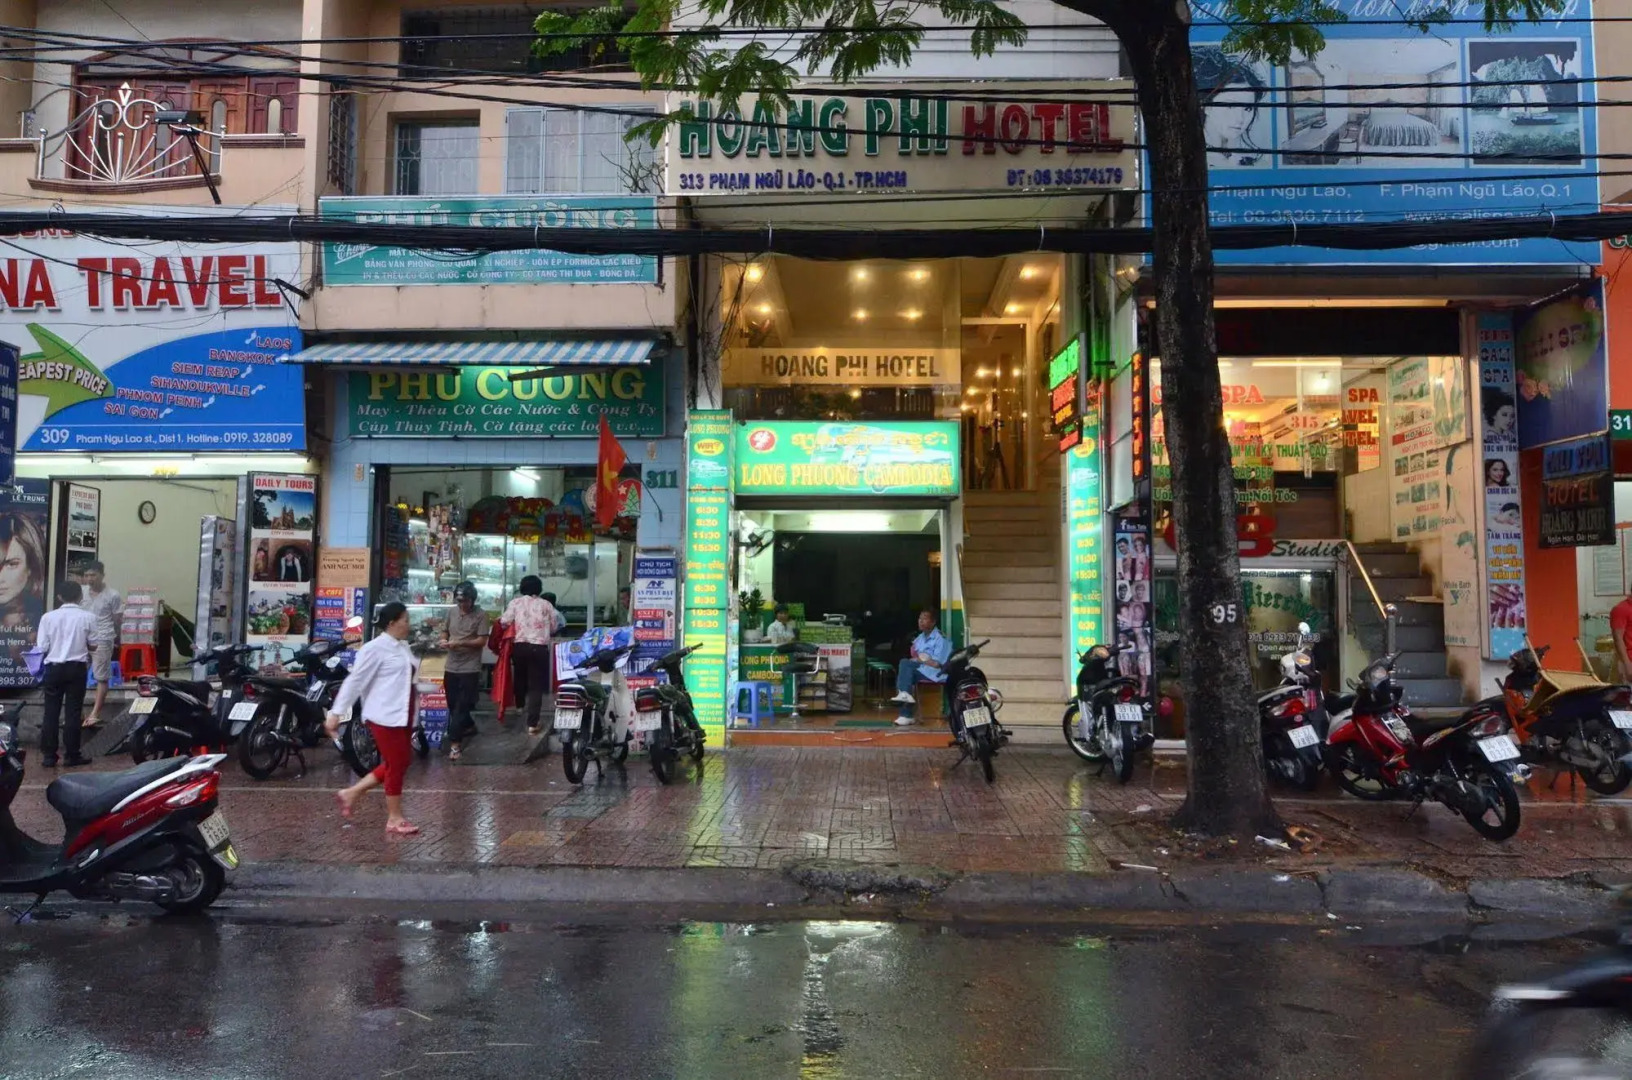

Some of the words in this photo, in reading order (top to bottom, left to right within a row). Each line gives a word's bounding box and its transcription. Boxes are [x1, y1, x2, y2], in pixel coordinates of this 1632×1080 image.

[864, 97, 949, 157] PHI
[962, 103, 1125, 155] HOTEL
[679, 173, 704, 190] 313
[1402, 184, 1453, 199] Phạm
[1459, 183, 1495, 199] Ngũ
[564, 258, 600, 266] FORMICA
[77, 255, 281, 307] TRAVEL
[256, 336, 292, 350] LAOS
[210, 349, 275, 365] BANGKOK
[171, 362, 202, 375] SIEM
[206, 365, 240, 378] REAP
[761, 355, 828, 377] HOANG
[835, 356, 868, 377] PHI
[876, 356, 940, 377] HOTEL
[150, 376, 251, 397] SIHANOUKVILLE
[116, 388, 164, 404] PHNOM
[167, 394, 203, 408] PENH
[1348, 388, 1379, 404] SPA
[104, 403, 126, 415] SAI
[129, 406, 159, 419] GON
[357, 402, 391, 418] May
[406, 403, 447, 416] Thêu
[453, 402, 476, 416] Cờ
[481, 401, 512, 416] Các
[568, 403, 581, 416] &
[359, 418, 388, 435] Cúp
[1291, 415, 1319, 429] 315
[41, 429, 70, 444] 309
[76, 433, 103, 444] Pham
[104, 433, 123, 446] Ngu
[124, 433, 146, 444] Lao
[158, 433, 175, 444] Dist
[646, 470, 679, 489] 311
[741, 463, 786, 486] LONG
[864, 463, 953, 486] CAMBODIA
[255, 478, 282, 489] DAILY
[285, 478, 314, 490] TOURS
[1213, 604, 1236, 623] 95
[15, 625, 33, 633] Hair
[7, 638, 26, 646] Here
[1257, 643, 1278, 652] Open
[18, 676, 35, 685] 307
